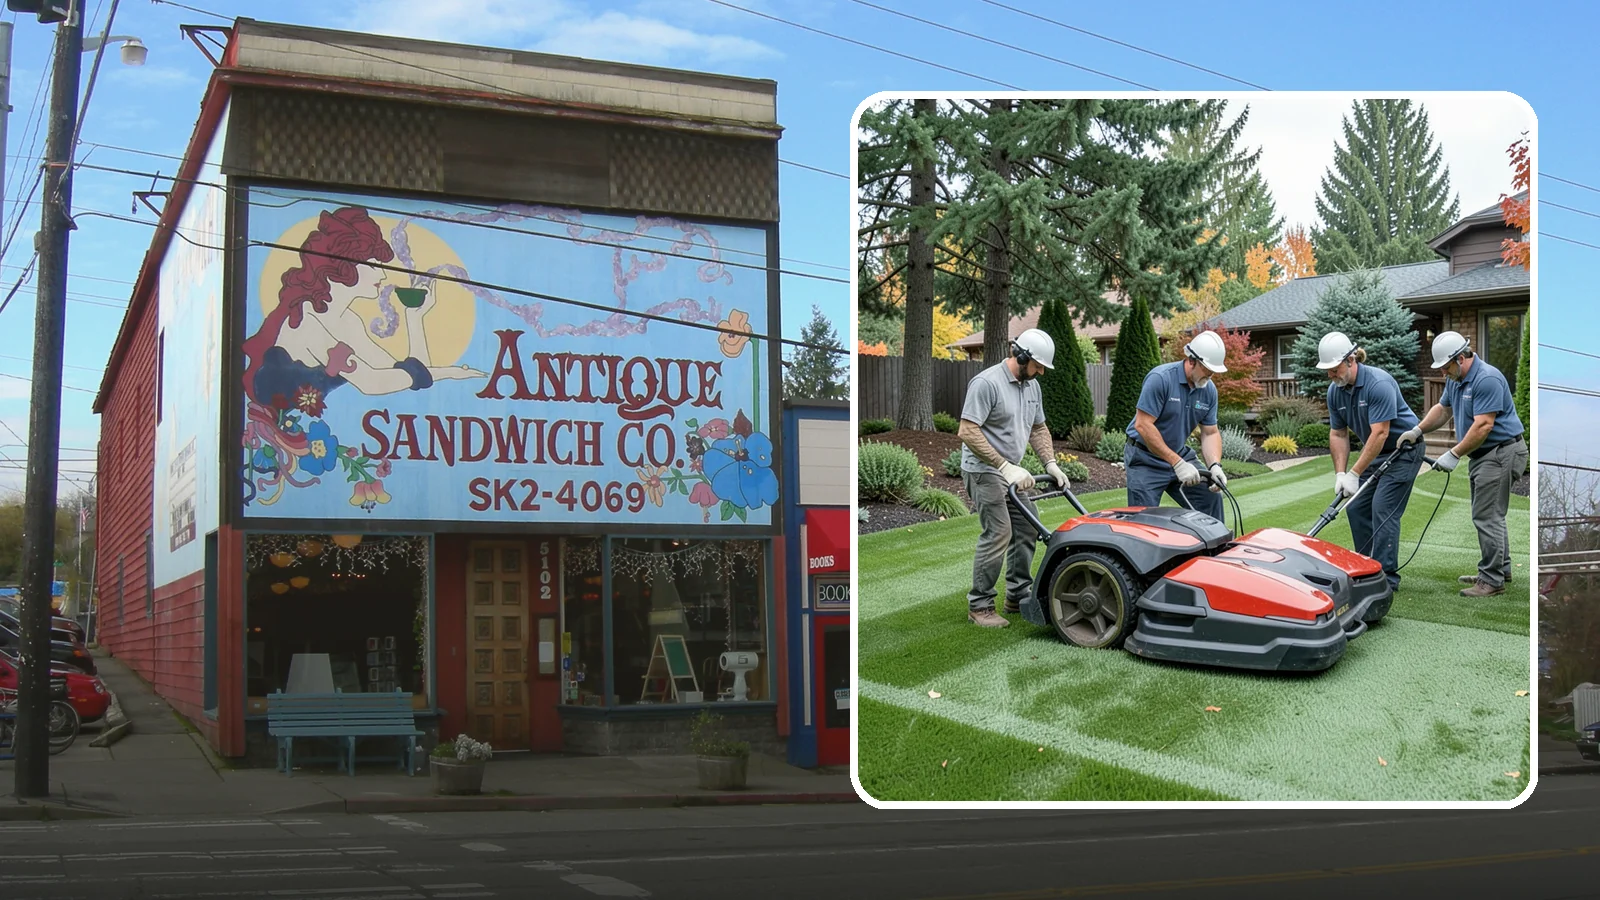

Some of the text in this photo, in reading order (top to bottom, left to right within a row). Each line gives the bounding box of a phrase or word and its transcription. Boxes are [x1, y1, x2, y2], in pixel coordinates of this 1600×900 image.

[475, 329, 724, 421] ANTIQUE
[361, 408, 685, 469] SANDWICH CO.
[468, 477, 646, 513] SK2-4069
[540, 541, 551, 599] 5102
[809, 555, 835, 569] BOOKS
